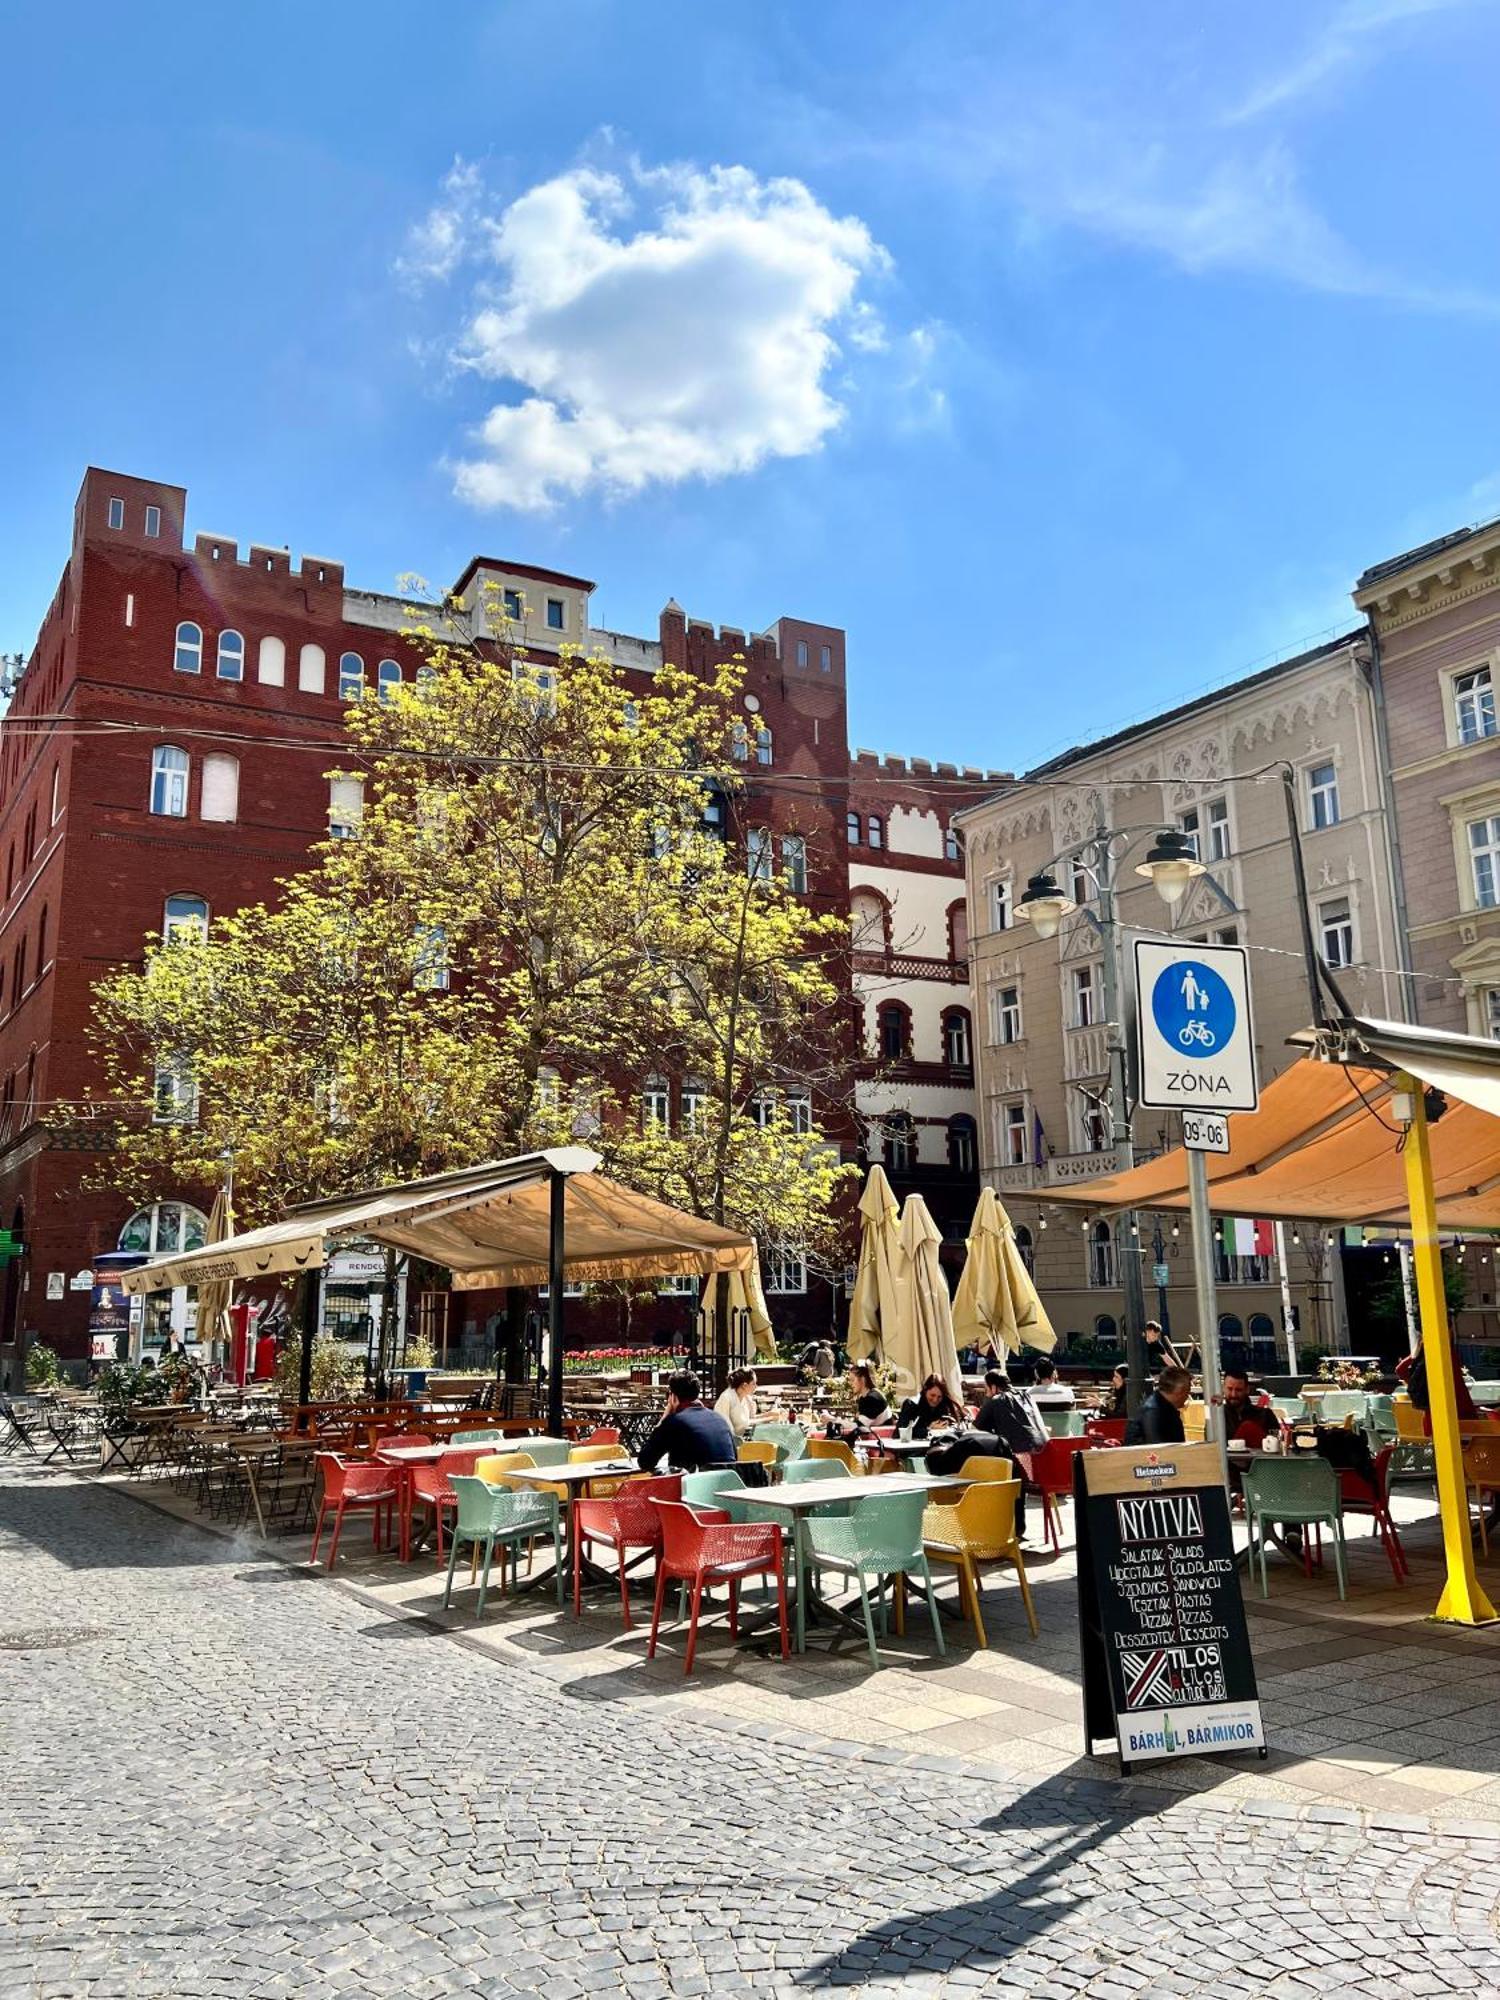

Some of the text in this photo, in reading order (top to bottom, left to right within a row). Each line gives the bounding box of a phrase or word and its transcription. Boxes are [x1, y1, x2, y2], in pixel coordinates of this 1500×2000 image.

[1135, 1464, 1175, 1477] Heineken
[1120, 1497, 1201, 1541] NYITVA
[1167, 1544, 1204, 1560] SALADS
[1173, 1576, 1221, 1592] SANDWICH
[1174, 1593, 1212, 1608] PASTAS
[1177, 1609, 1213, 1625] PIZZAS
[1180, 1626, 1229, 1642] DESSERTS
[1167, 1646, 1220, 1669] TILOS
[1129, 1723, 1255, 1751] BÁRHL, BÁRMIKOR
